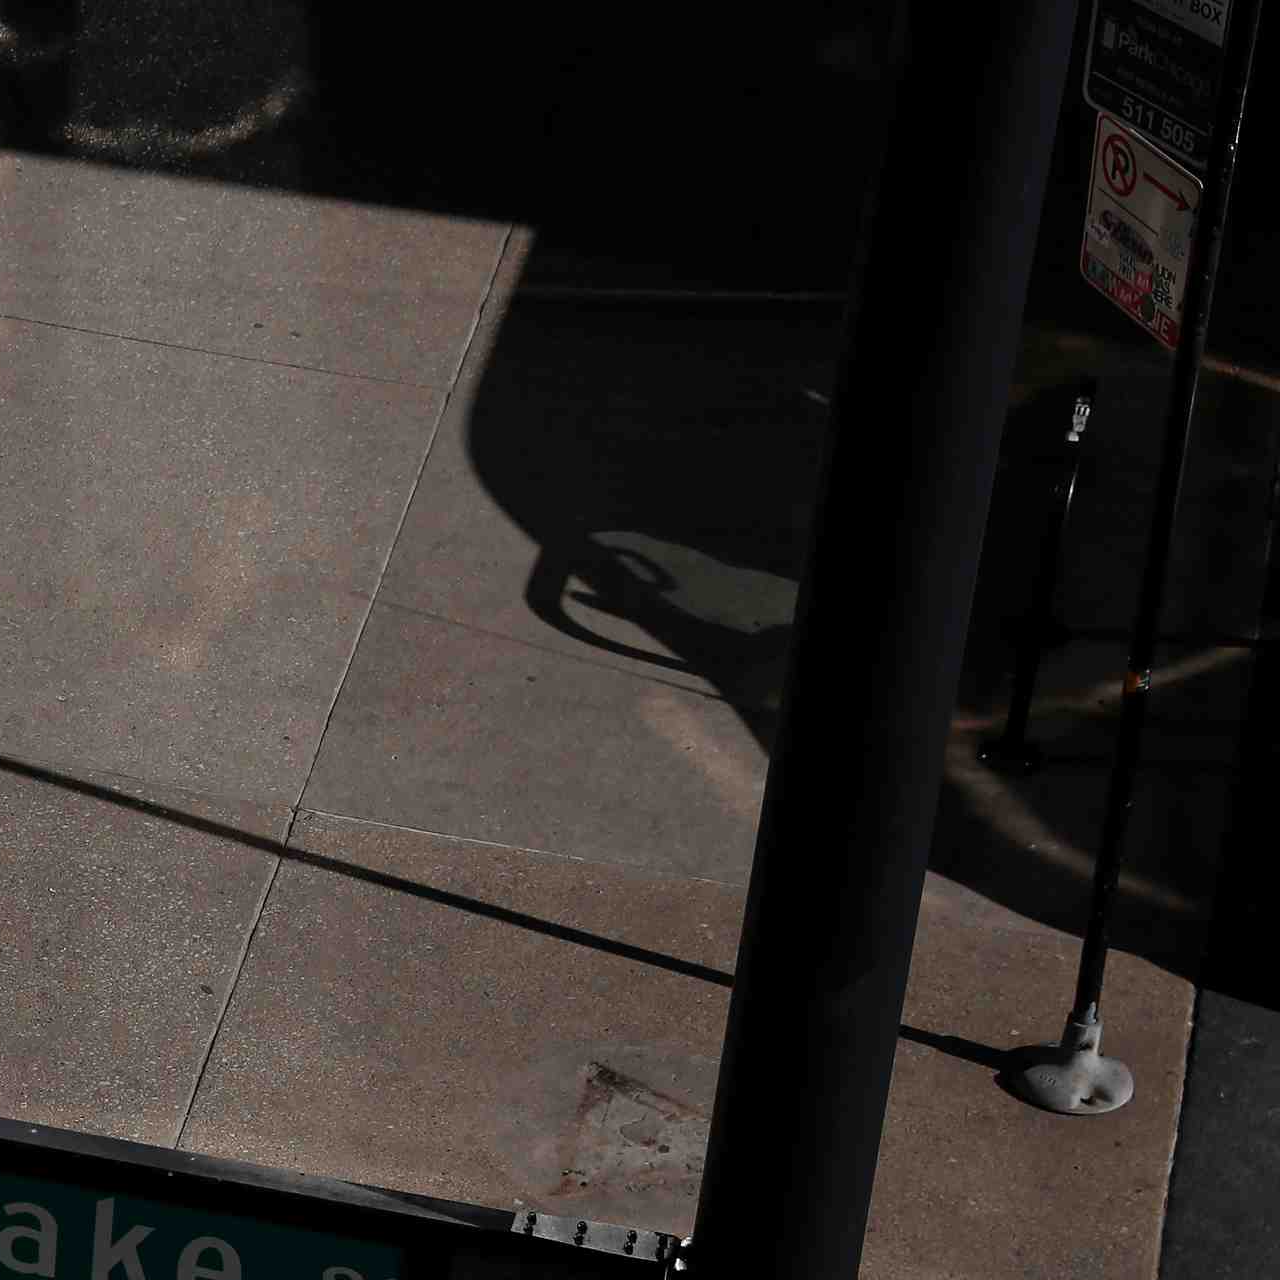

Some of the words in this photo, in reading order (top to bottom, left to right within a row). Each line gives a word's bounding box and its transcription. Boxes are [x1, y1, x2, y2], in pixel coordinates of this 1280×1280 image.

[1191, 1, 1223, 25] BOX
[1121, 97, 1154, 130] 511
[1160, 118, 1196, 151] 505
